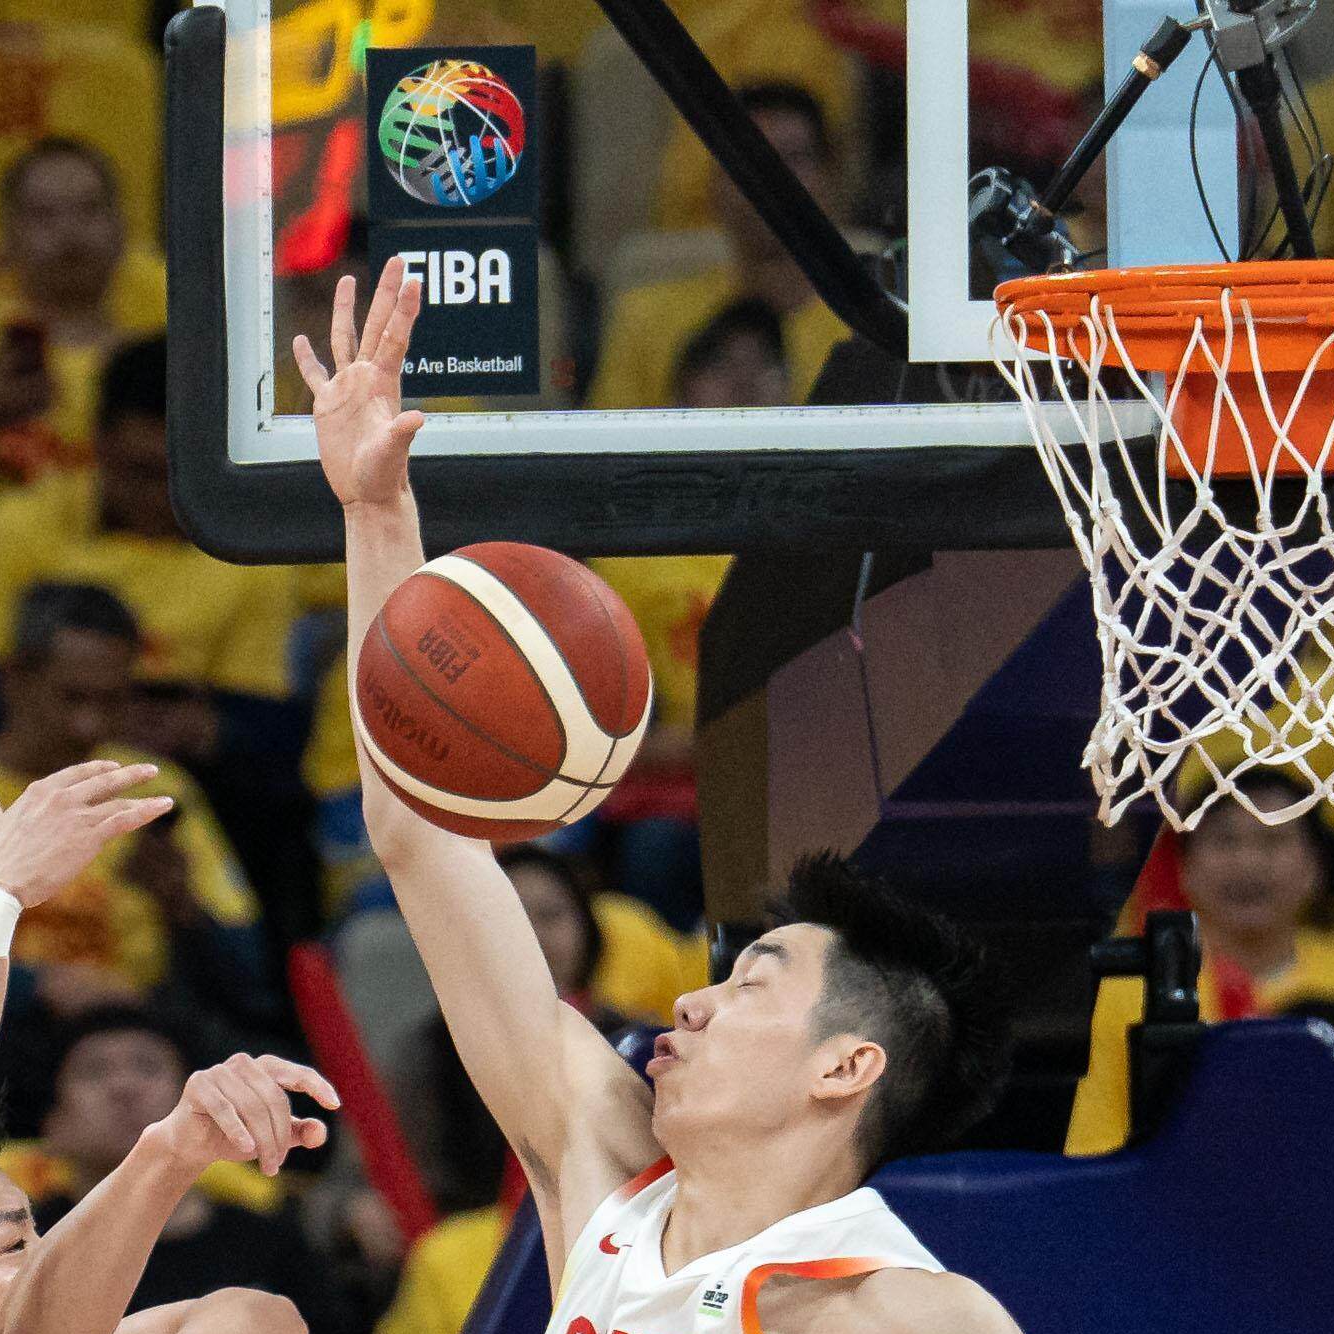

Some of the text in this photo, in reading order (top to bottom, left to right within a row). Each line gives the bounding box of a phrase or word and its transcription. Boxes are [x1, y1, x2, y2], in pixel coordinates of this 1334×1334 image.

[400, 356, 523, 374] e Are Basketball
